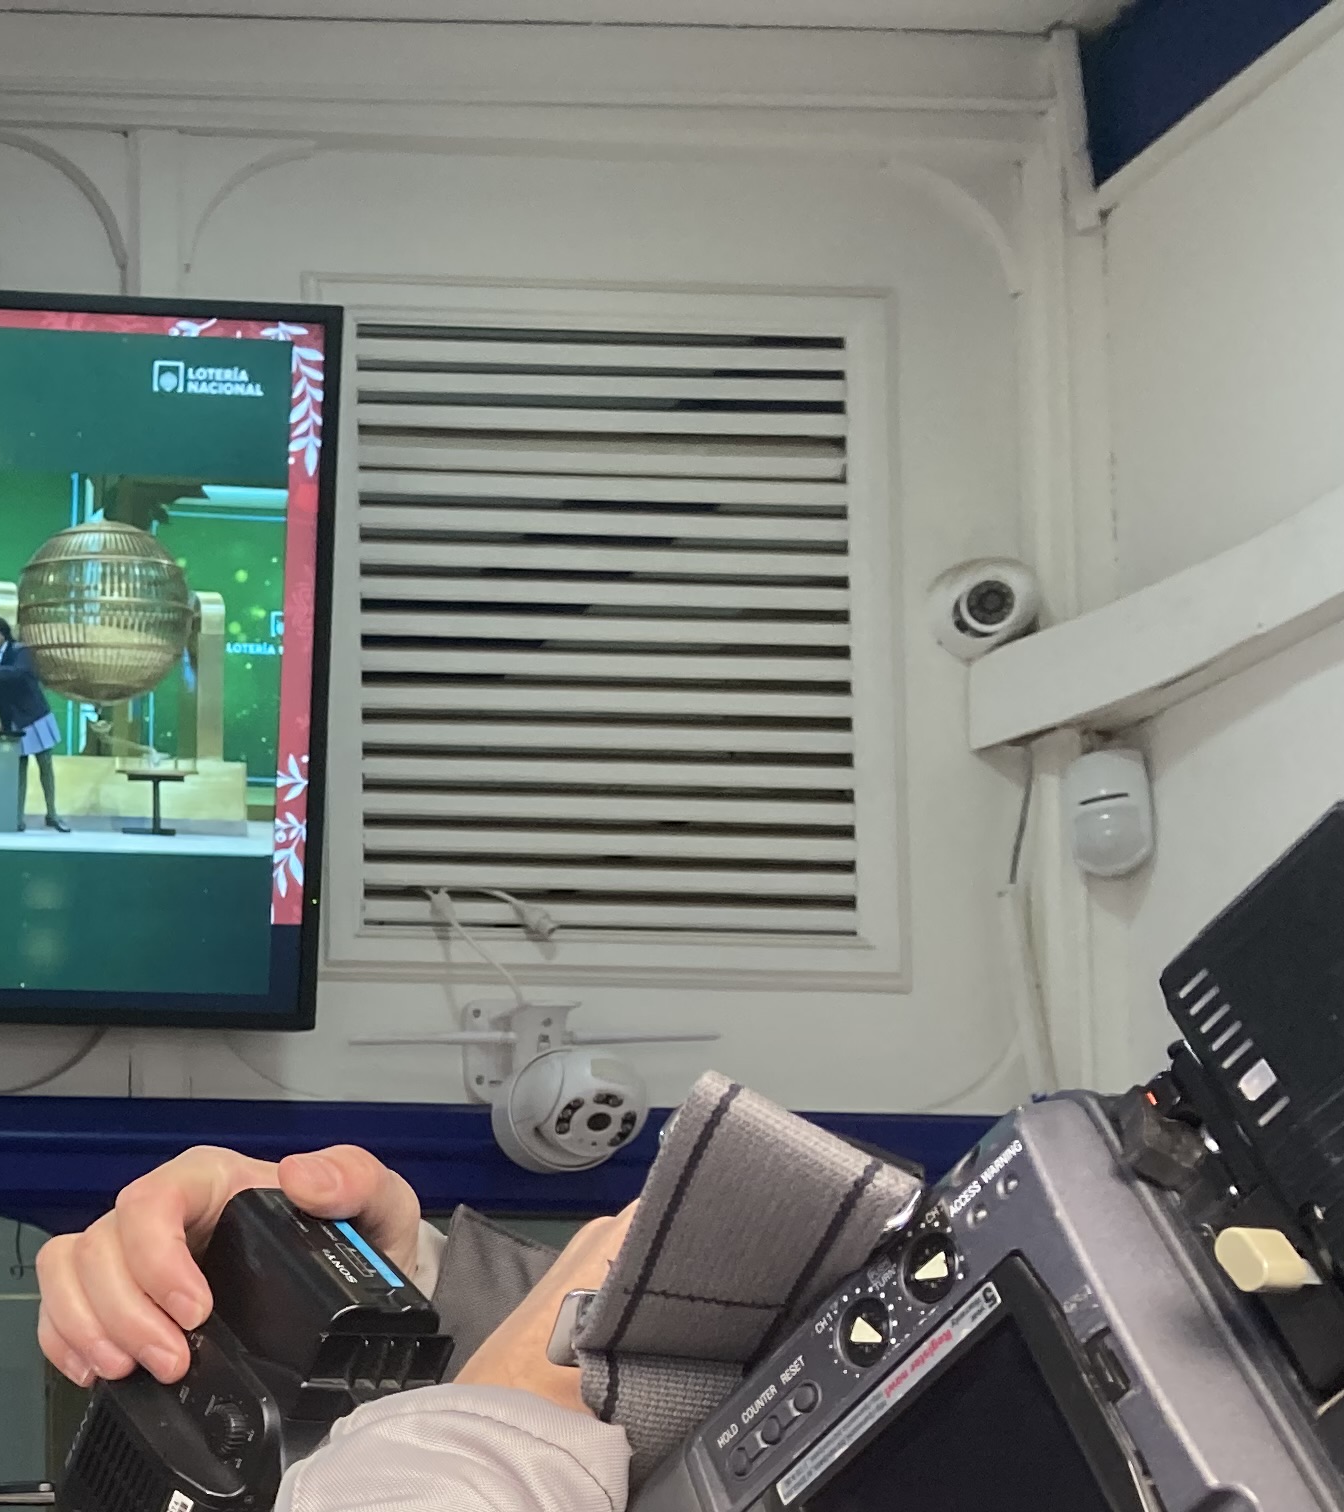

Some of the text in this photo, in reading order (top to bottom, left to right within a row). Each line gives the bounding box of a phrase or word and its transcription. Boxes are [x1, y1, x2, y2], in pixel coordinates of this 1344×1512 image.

[186, 366, 249, 382] LOTERÍA
[186, 381, 264, 397] NACIONAL
[949, 1138, 1023, 1218] ACCESS WARNING
[982, 1287, 998, 1309] 5
[911, 1328, 954, 1373] Register
[716, 1354, 806, 1449] HOLD COUNTER RESET
